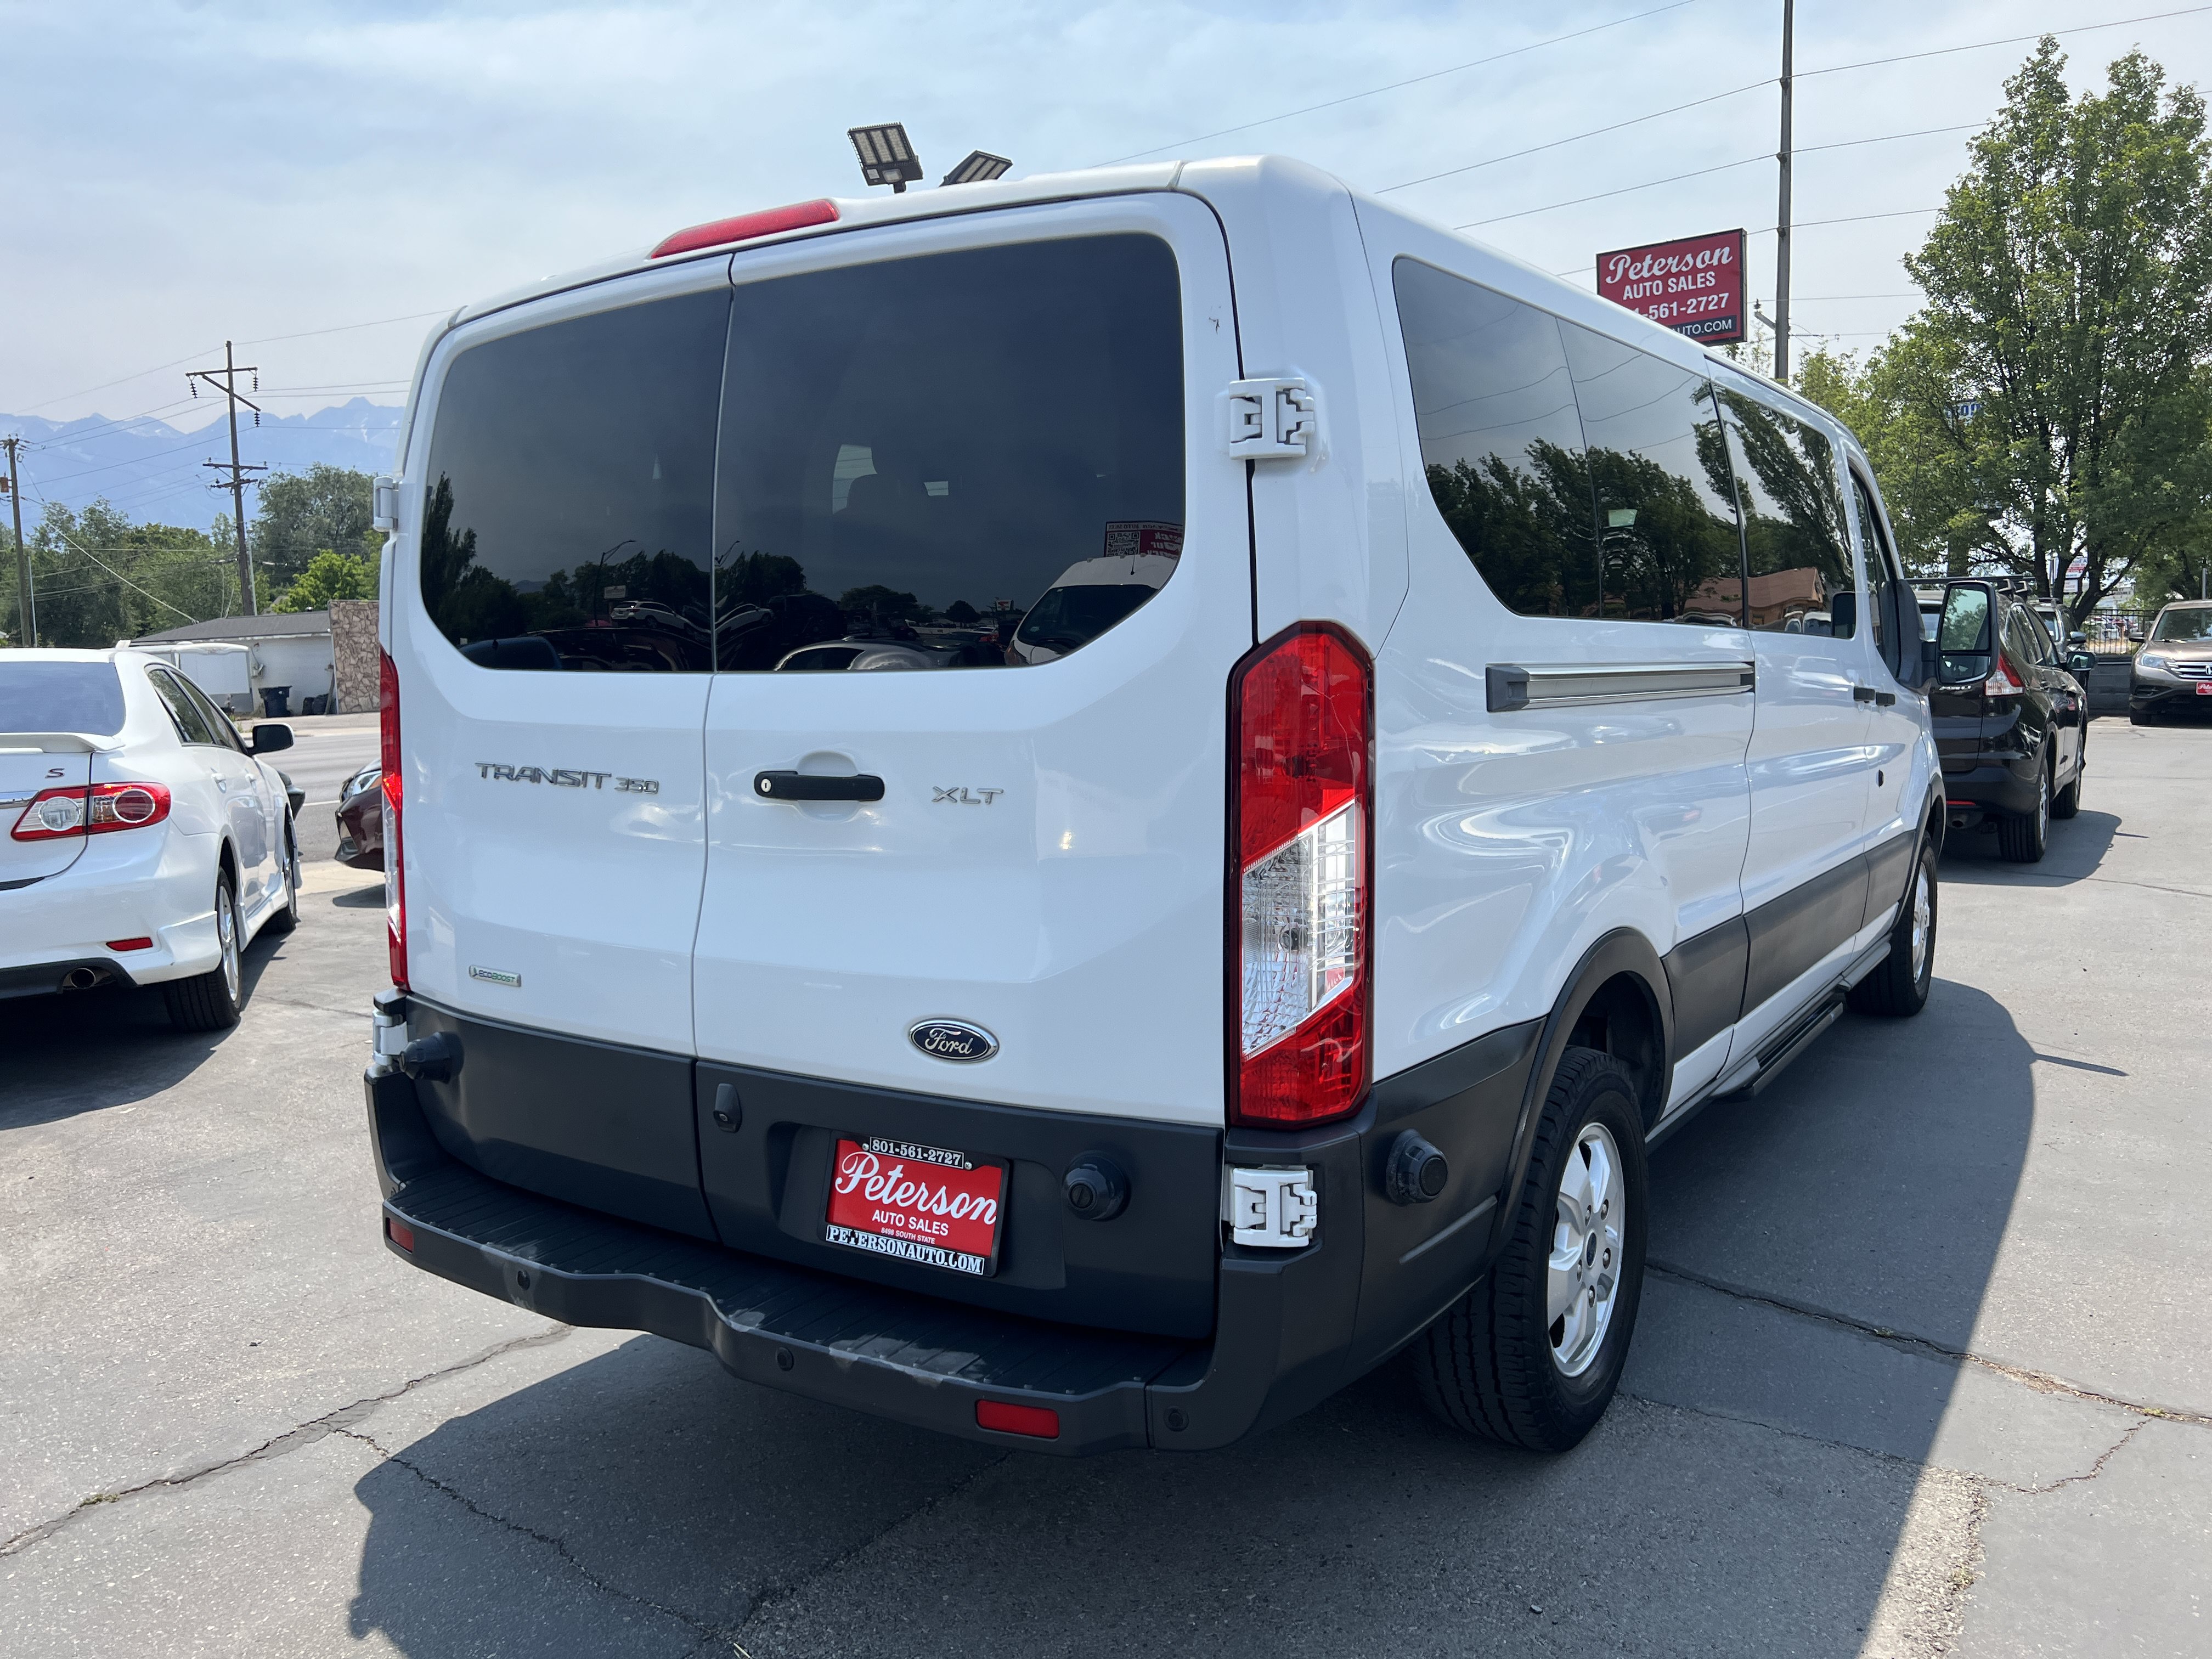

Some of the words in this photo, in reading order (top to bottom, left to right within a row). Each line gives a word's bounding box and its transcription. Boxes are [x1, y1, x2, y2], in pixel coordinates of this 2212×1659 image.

[1605, 246, 1733, 284] Peterson
[1623, 280, 1663, 301] AUTO
[1668, 271, 1716, 294] SALES
[1671, 319, 1732, 336] UTO.COM
[44, 768, 65, 779] S
[475, 761, 612, 789] TRANSIT
[614, 777, 659, 794] 350
[931, 786, 1004, 805] XLT
[924, 1028, 974, 1054] Ford
[872, 1139, 962, 1166] 801-561-2727
[834, 1151, 997, 1225] Peterson
[871, 1209, 905, 1227] AUTO
[908, 1216, 949, 1237] SALES
[828, 1226, 982, 1273] PETERSONAUTO.COM
[895, 1229, 916, 1240] SOUTH
[917, 1234, 936, 1245] STATE
